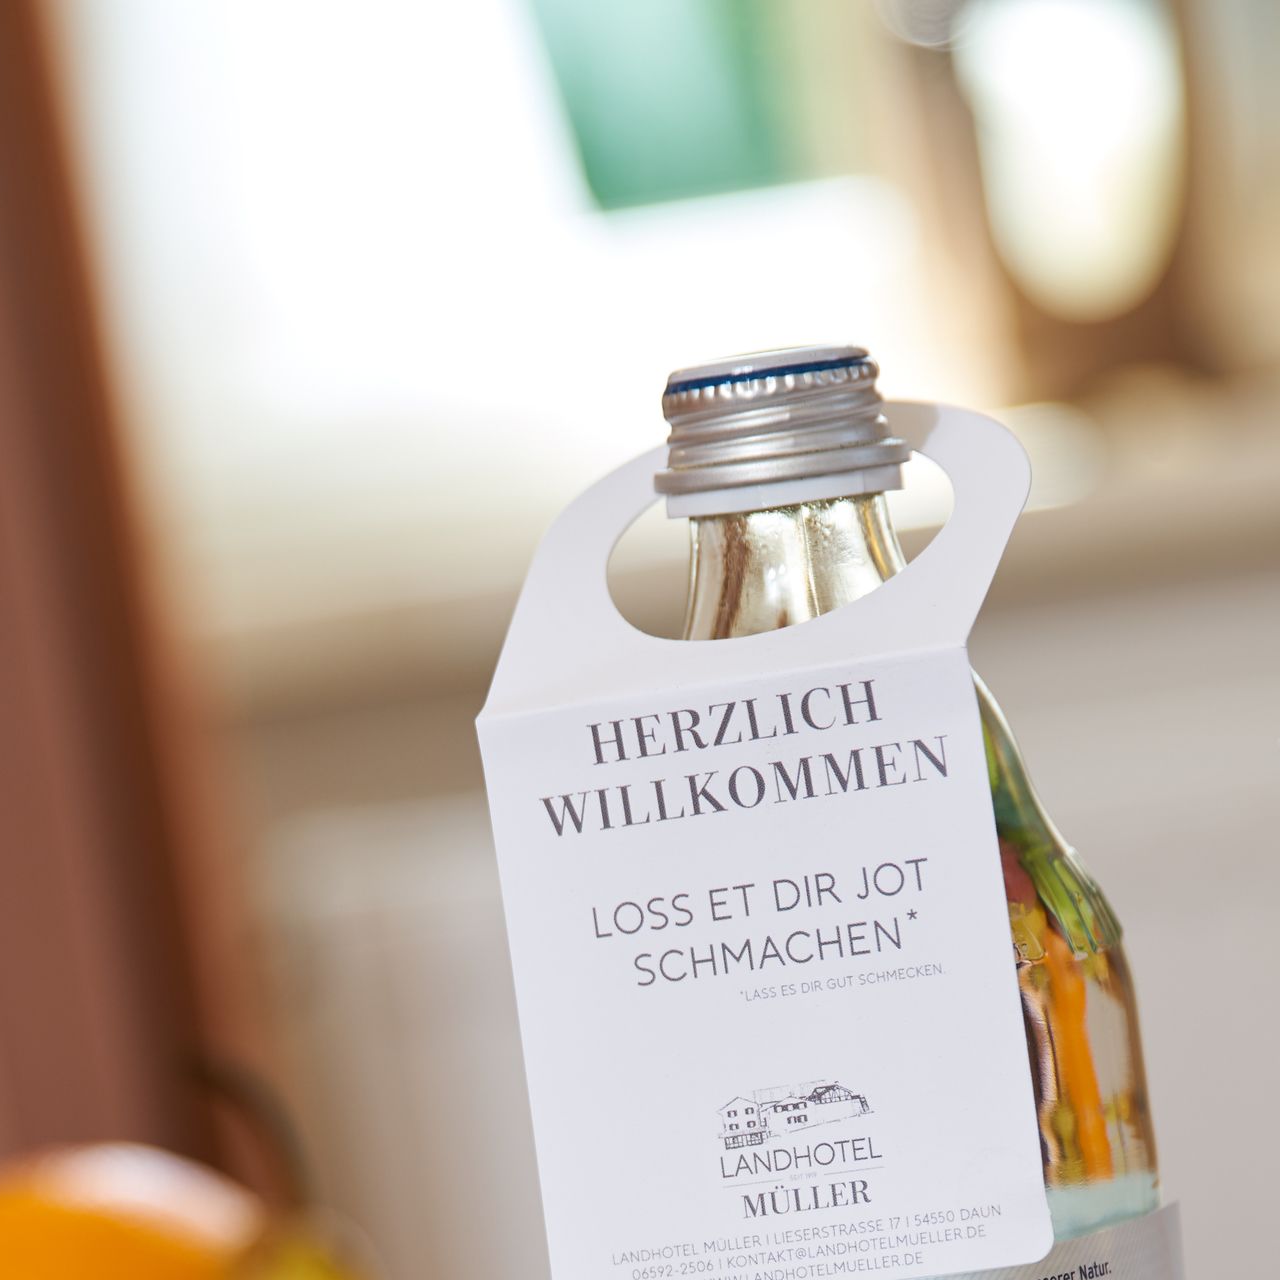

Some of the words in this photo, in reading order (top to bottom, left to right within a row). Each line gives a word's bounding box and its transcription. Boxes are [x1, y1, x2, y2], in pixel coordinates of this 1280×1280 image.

[586, 679, 883, 765] HERZLICH
[539, 735, 949, 837] WILLKOMMEN
[592, 894, 694, 939] LOSS
[709, 884, 755, 922] ET
[772, 872, 842, 914] DIR
[856, 858, 929, 899] JOT
[781, 984, 797, 997] ES
[801, 980, 823, 994] DIR
[827, 976, 854, 991] GUT
[858, 963, 946, 986] SCHMECKEN.
[720, 1136, 883, 1178] LANDHOTEL
[741, 1179, 872, 1219] MÜLLER
[612, 1243, 699, 1266] LANDHOTEL
[704, 1234, 762, 1253] MÜLLER
[774, 1218, 884, 1245] LIESERSTRASSE
[888, 1217, 900, 1230] 17
[914, 1210, 955, 1227] 54550
[960, 1204, 1002, 1221] DAUN
[632, 1261, 714, 1280] 06592-2506
[726, 1224, 986, 1269] KONTAKT@LANDHOTELMUELLER.DE
